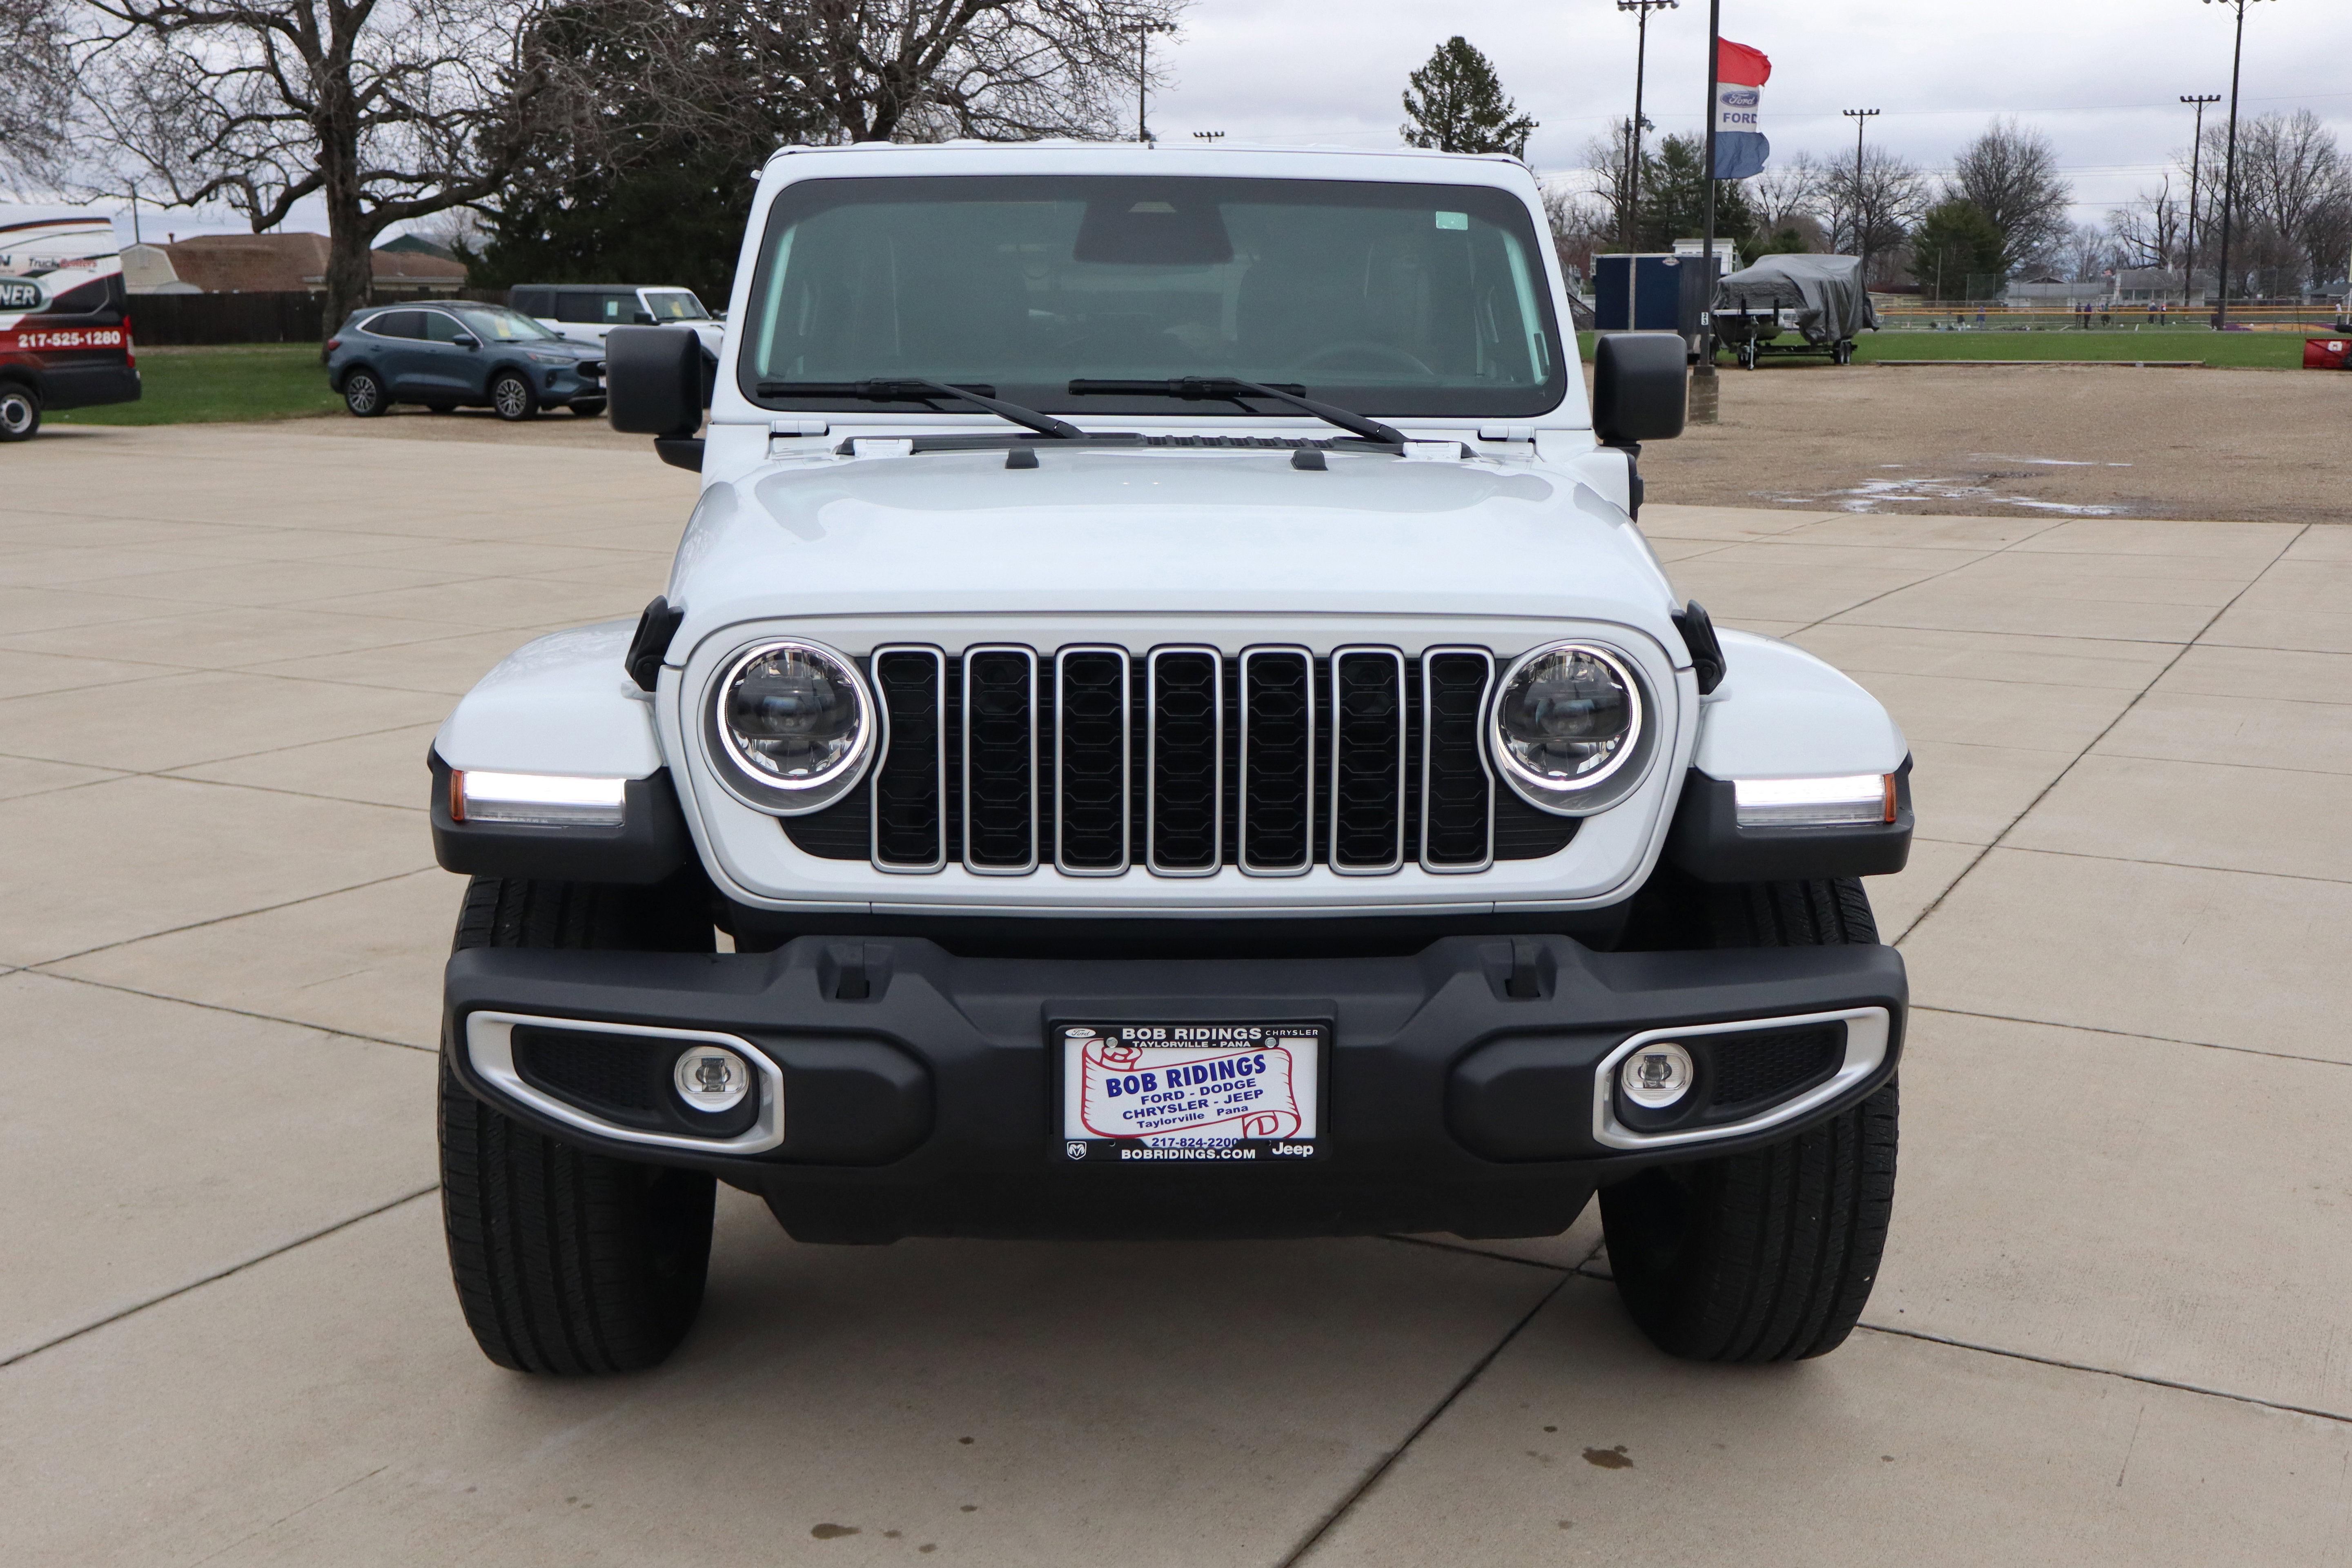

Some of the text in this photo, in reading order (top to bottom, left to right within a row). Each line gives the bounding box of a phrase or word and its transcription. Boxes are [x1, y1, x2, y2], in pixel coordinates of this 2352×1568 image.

[1729, 94, 1755, 104] Ford
[1723, 113, 1757, 124] FORD
[18, 330, 121, 348] 217-525-1280
[1123, 1028, 1262, 1040] BOB RIDINGS
[1106, 1054, 1266, 1098] BOB RIDINGS
[1140, 1090, 1185, 1105] FORD
[1200, 1078, 1257, 1096] DODGE
[1123, 1099, 1209, 1120] CHRYSLER
[1223, 1089, 1264, 1104] JEEP
[1136, 1105, 1249, 1129] Taylorville Pana
[1152, 1137, 1239, 1147] 217-824-2200
[1272, 1142, 1314, 1157] Jeep
[1122, 1149, 1256, 1159] BOBRIDINGS.COM
